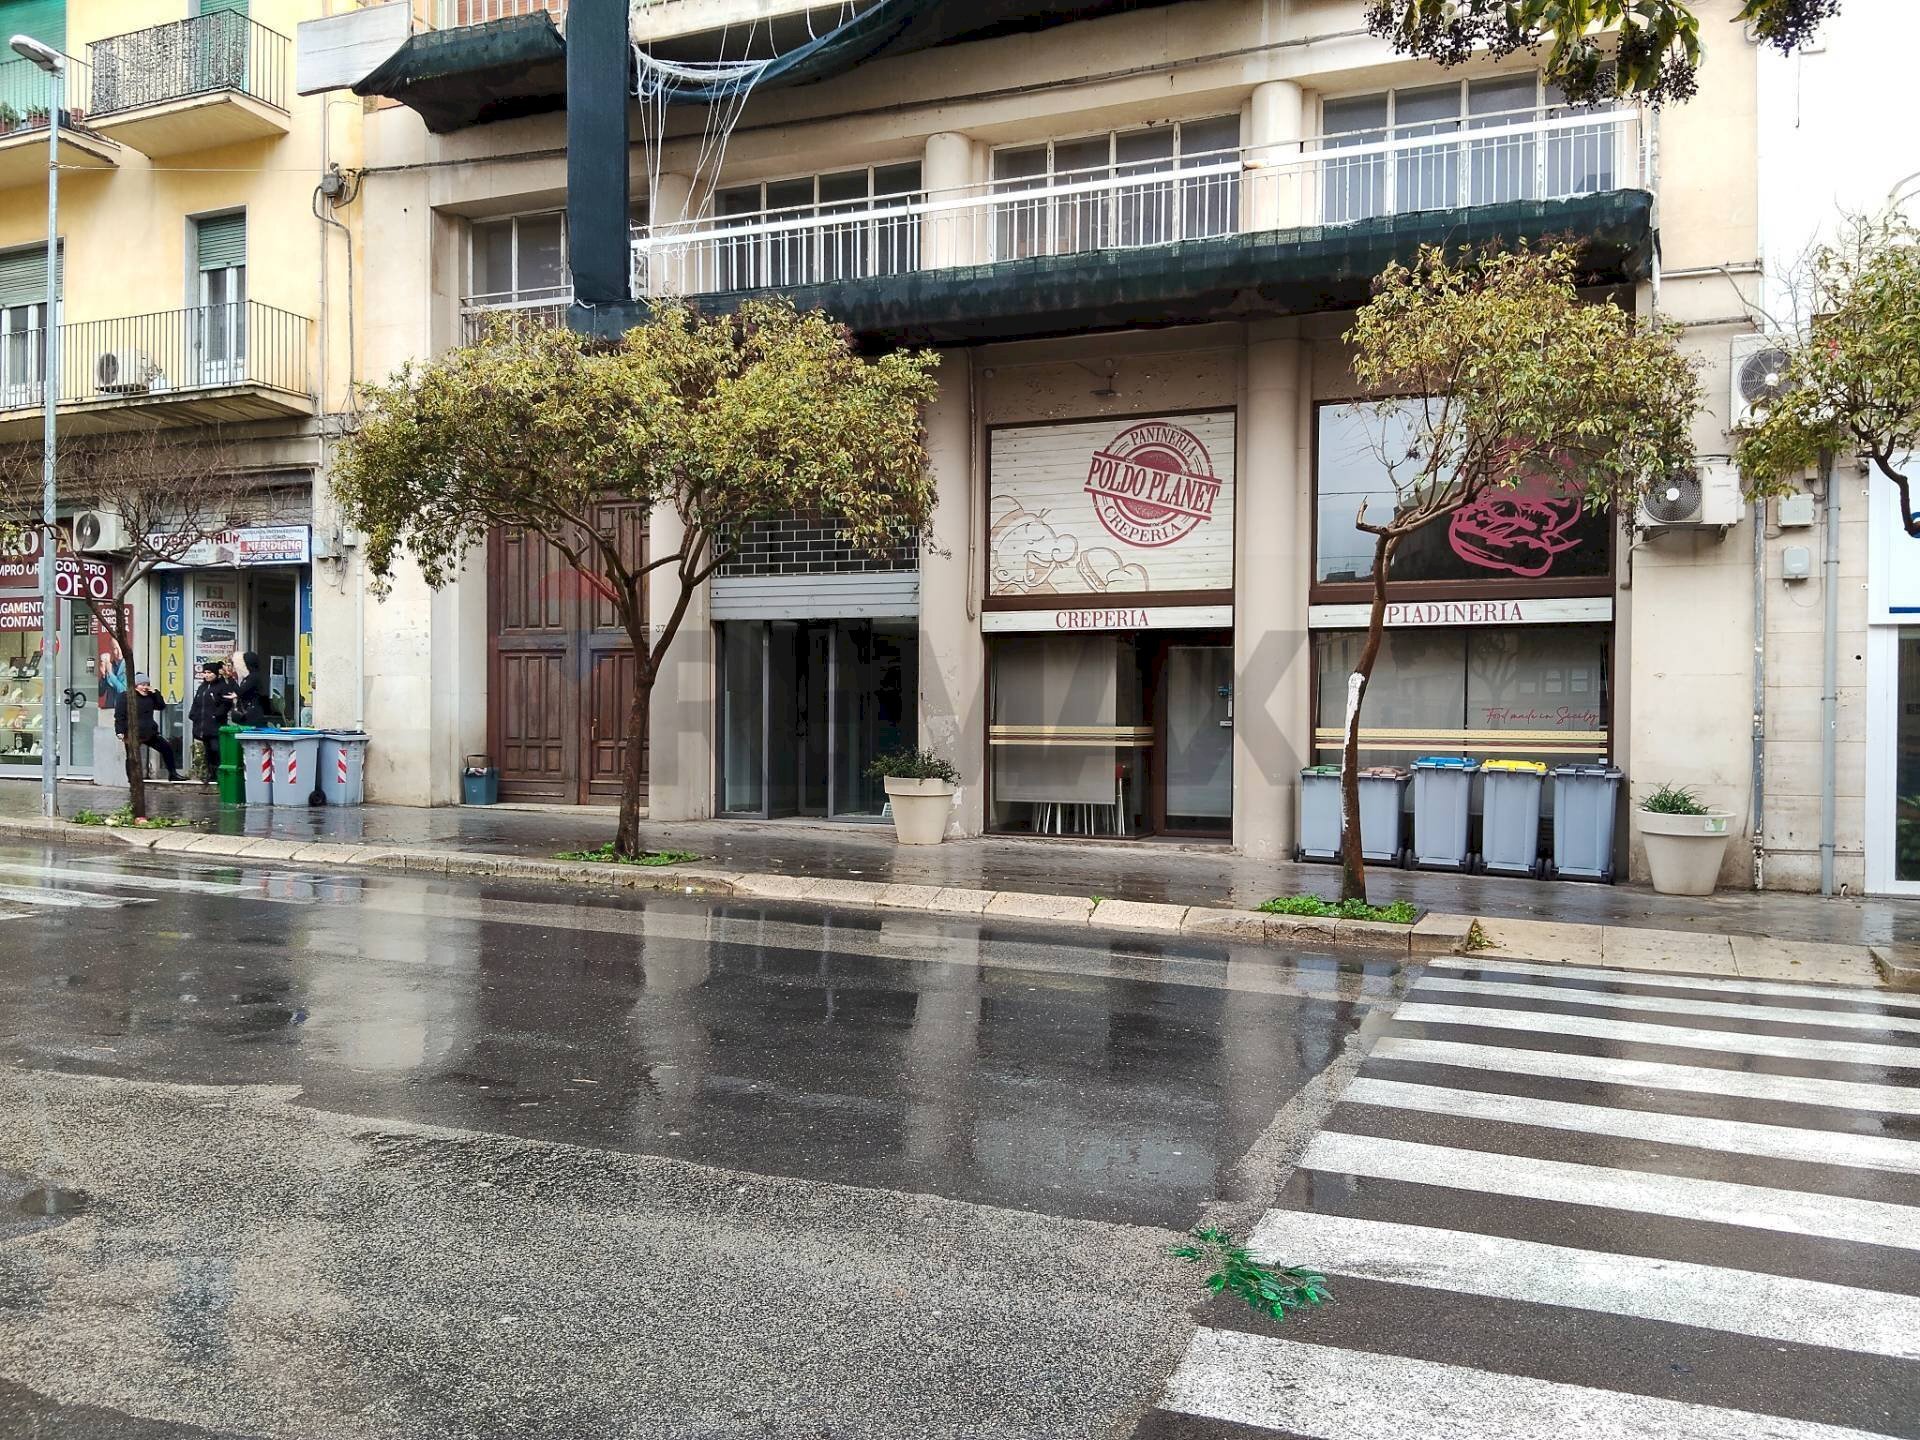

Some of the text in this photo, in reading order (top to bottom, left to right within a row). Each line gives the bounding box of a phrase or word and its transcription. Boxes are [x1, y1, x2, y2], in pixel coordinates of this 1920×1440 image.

[1130, 426, 1197, 459] PANINERIA
[1085, 457, 1220, 514] POLDO PLANET
[1103, 504, 1181, 542] CREPERIA
[0, 602, 44, 613] GAMENT
[1386, 602, 1523, 623] PIADINERIA
[1056, 609, 1149, 628] CREPERIA
[1482, 707, 1509, 724] Food
[1510, 709, 1537, 724] made
